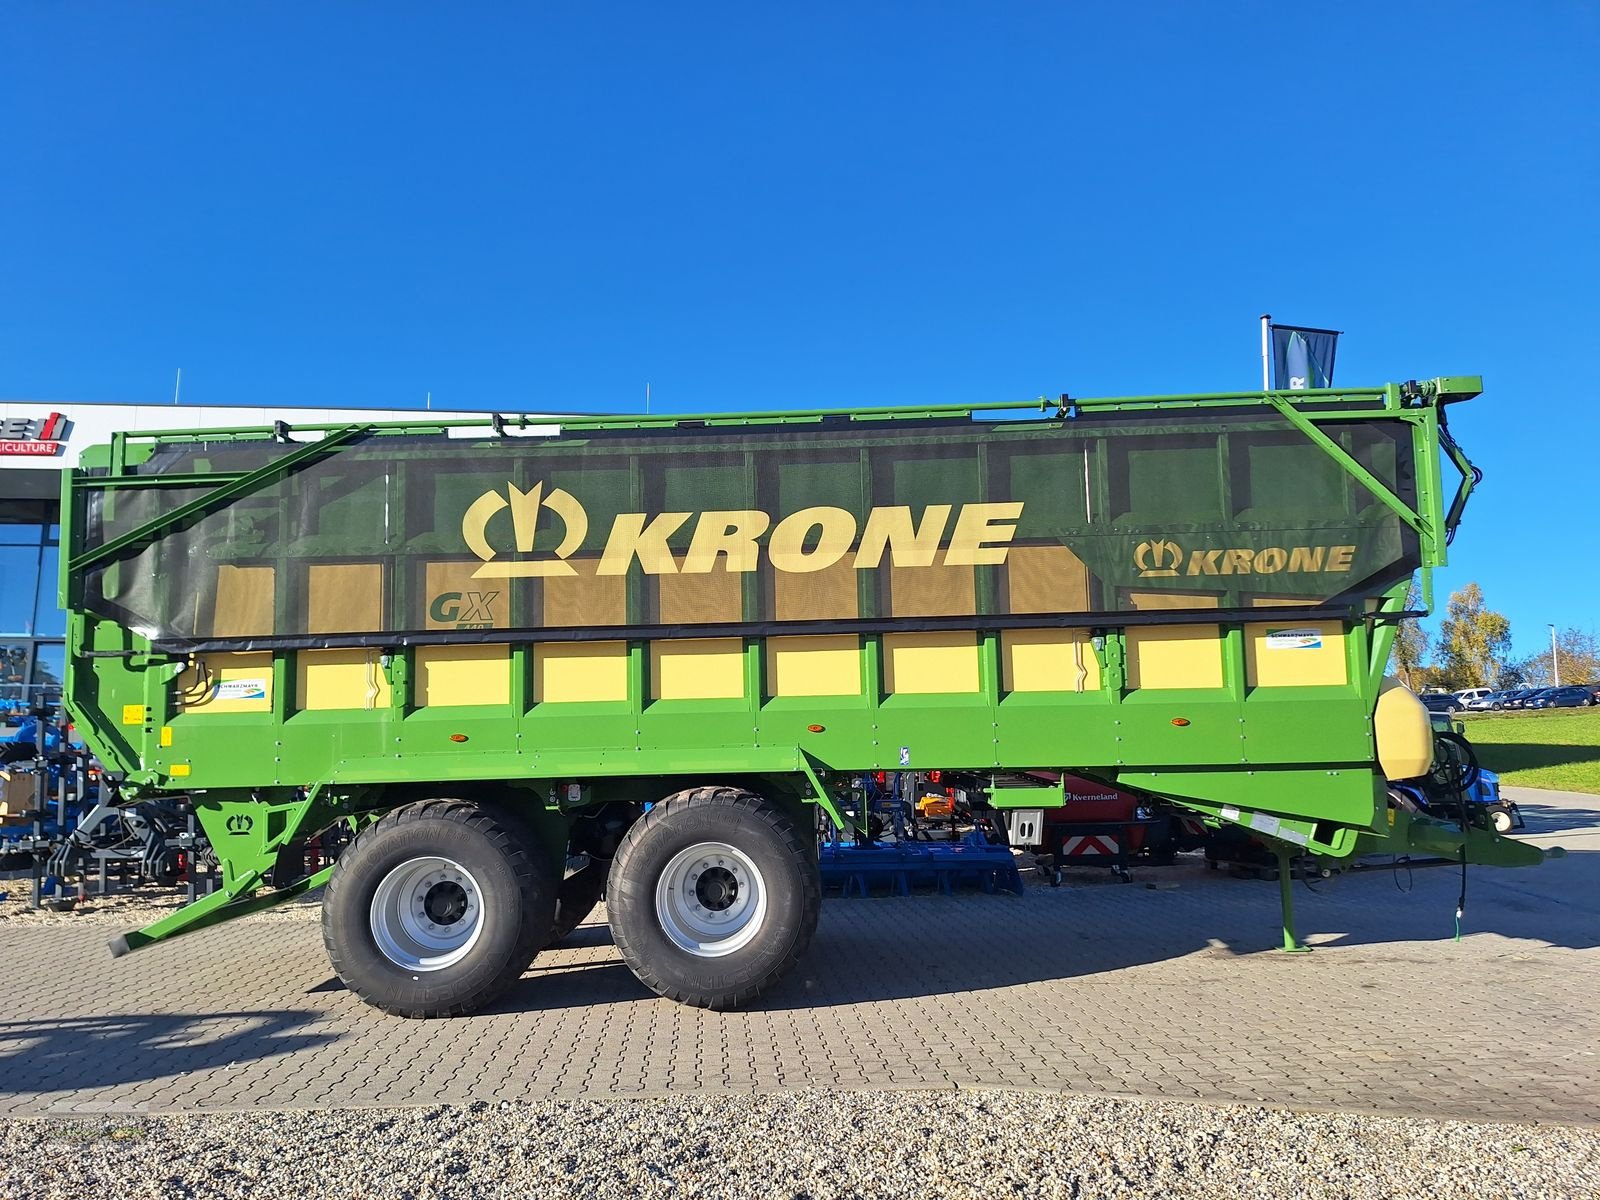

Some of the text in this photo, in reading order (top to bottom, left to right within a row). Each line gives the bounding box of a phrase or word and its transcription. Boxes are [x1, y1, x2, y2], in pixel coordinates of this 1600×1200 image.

[0, 442, 53, 453] ICULTURE
[595, 502, 1025, 575] KRONE
[1186, 545, 1356, 576] KRONE
[430, 591, 500, 622] GX
[1072, 793, 1119, 801] Kverneland
